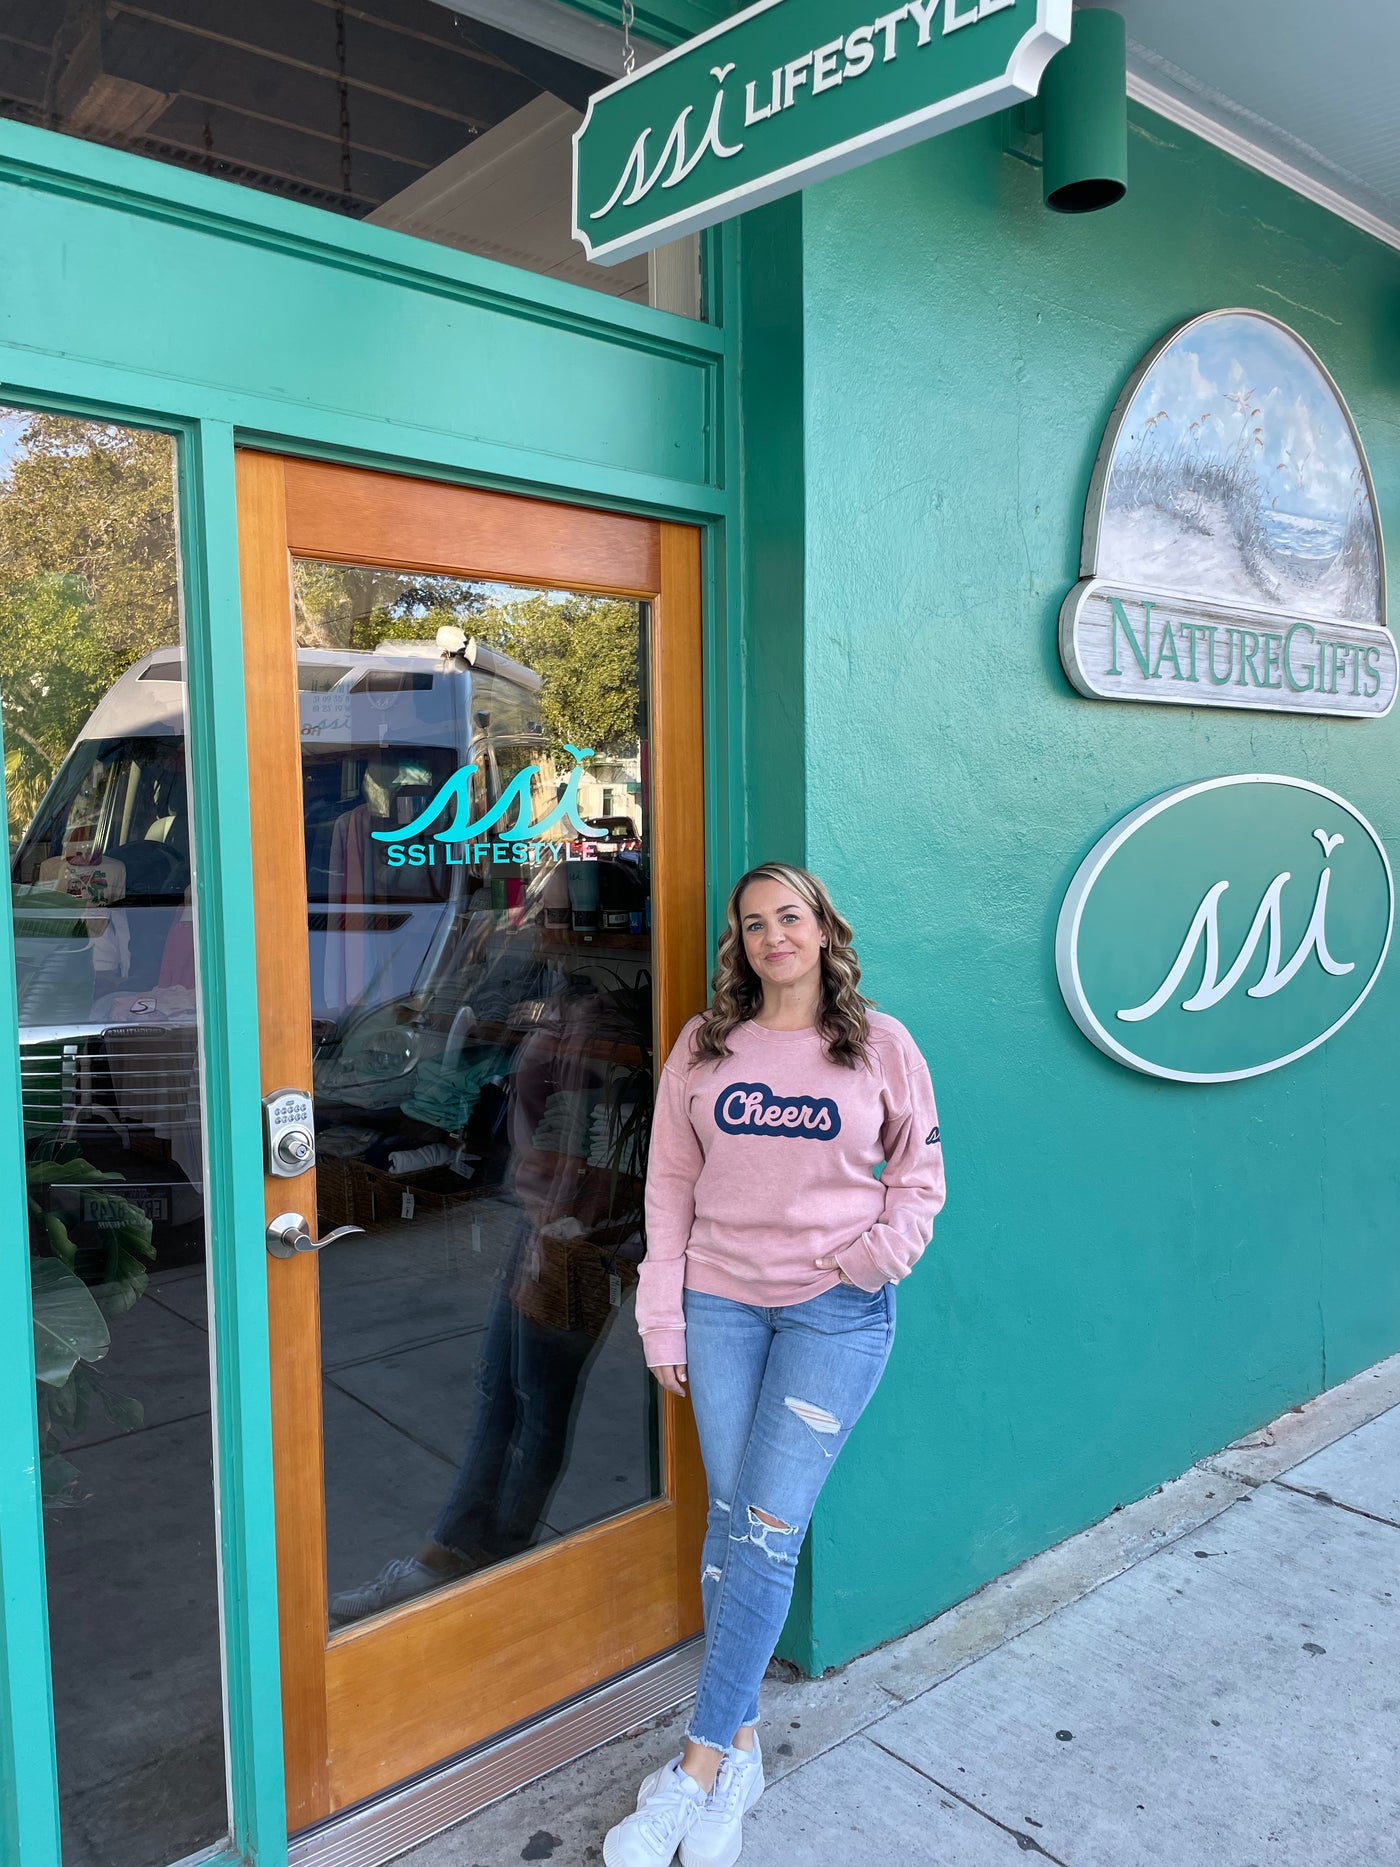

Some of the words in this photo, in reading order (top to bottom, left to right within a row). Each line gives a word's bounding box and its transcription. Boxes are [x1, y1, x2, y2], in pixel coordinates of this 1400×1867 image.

[387, 842, 435, 867] SSI
[445, 841, 599, 866] LIFESTYLE
[722, 1090, 832, 1131] Cheers
